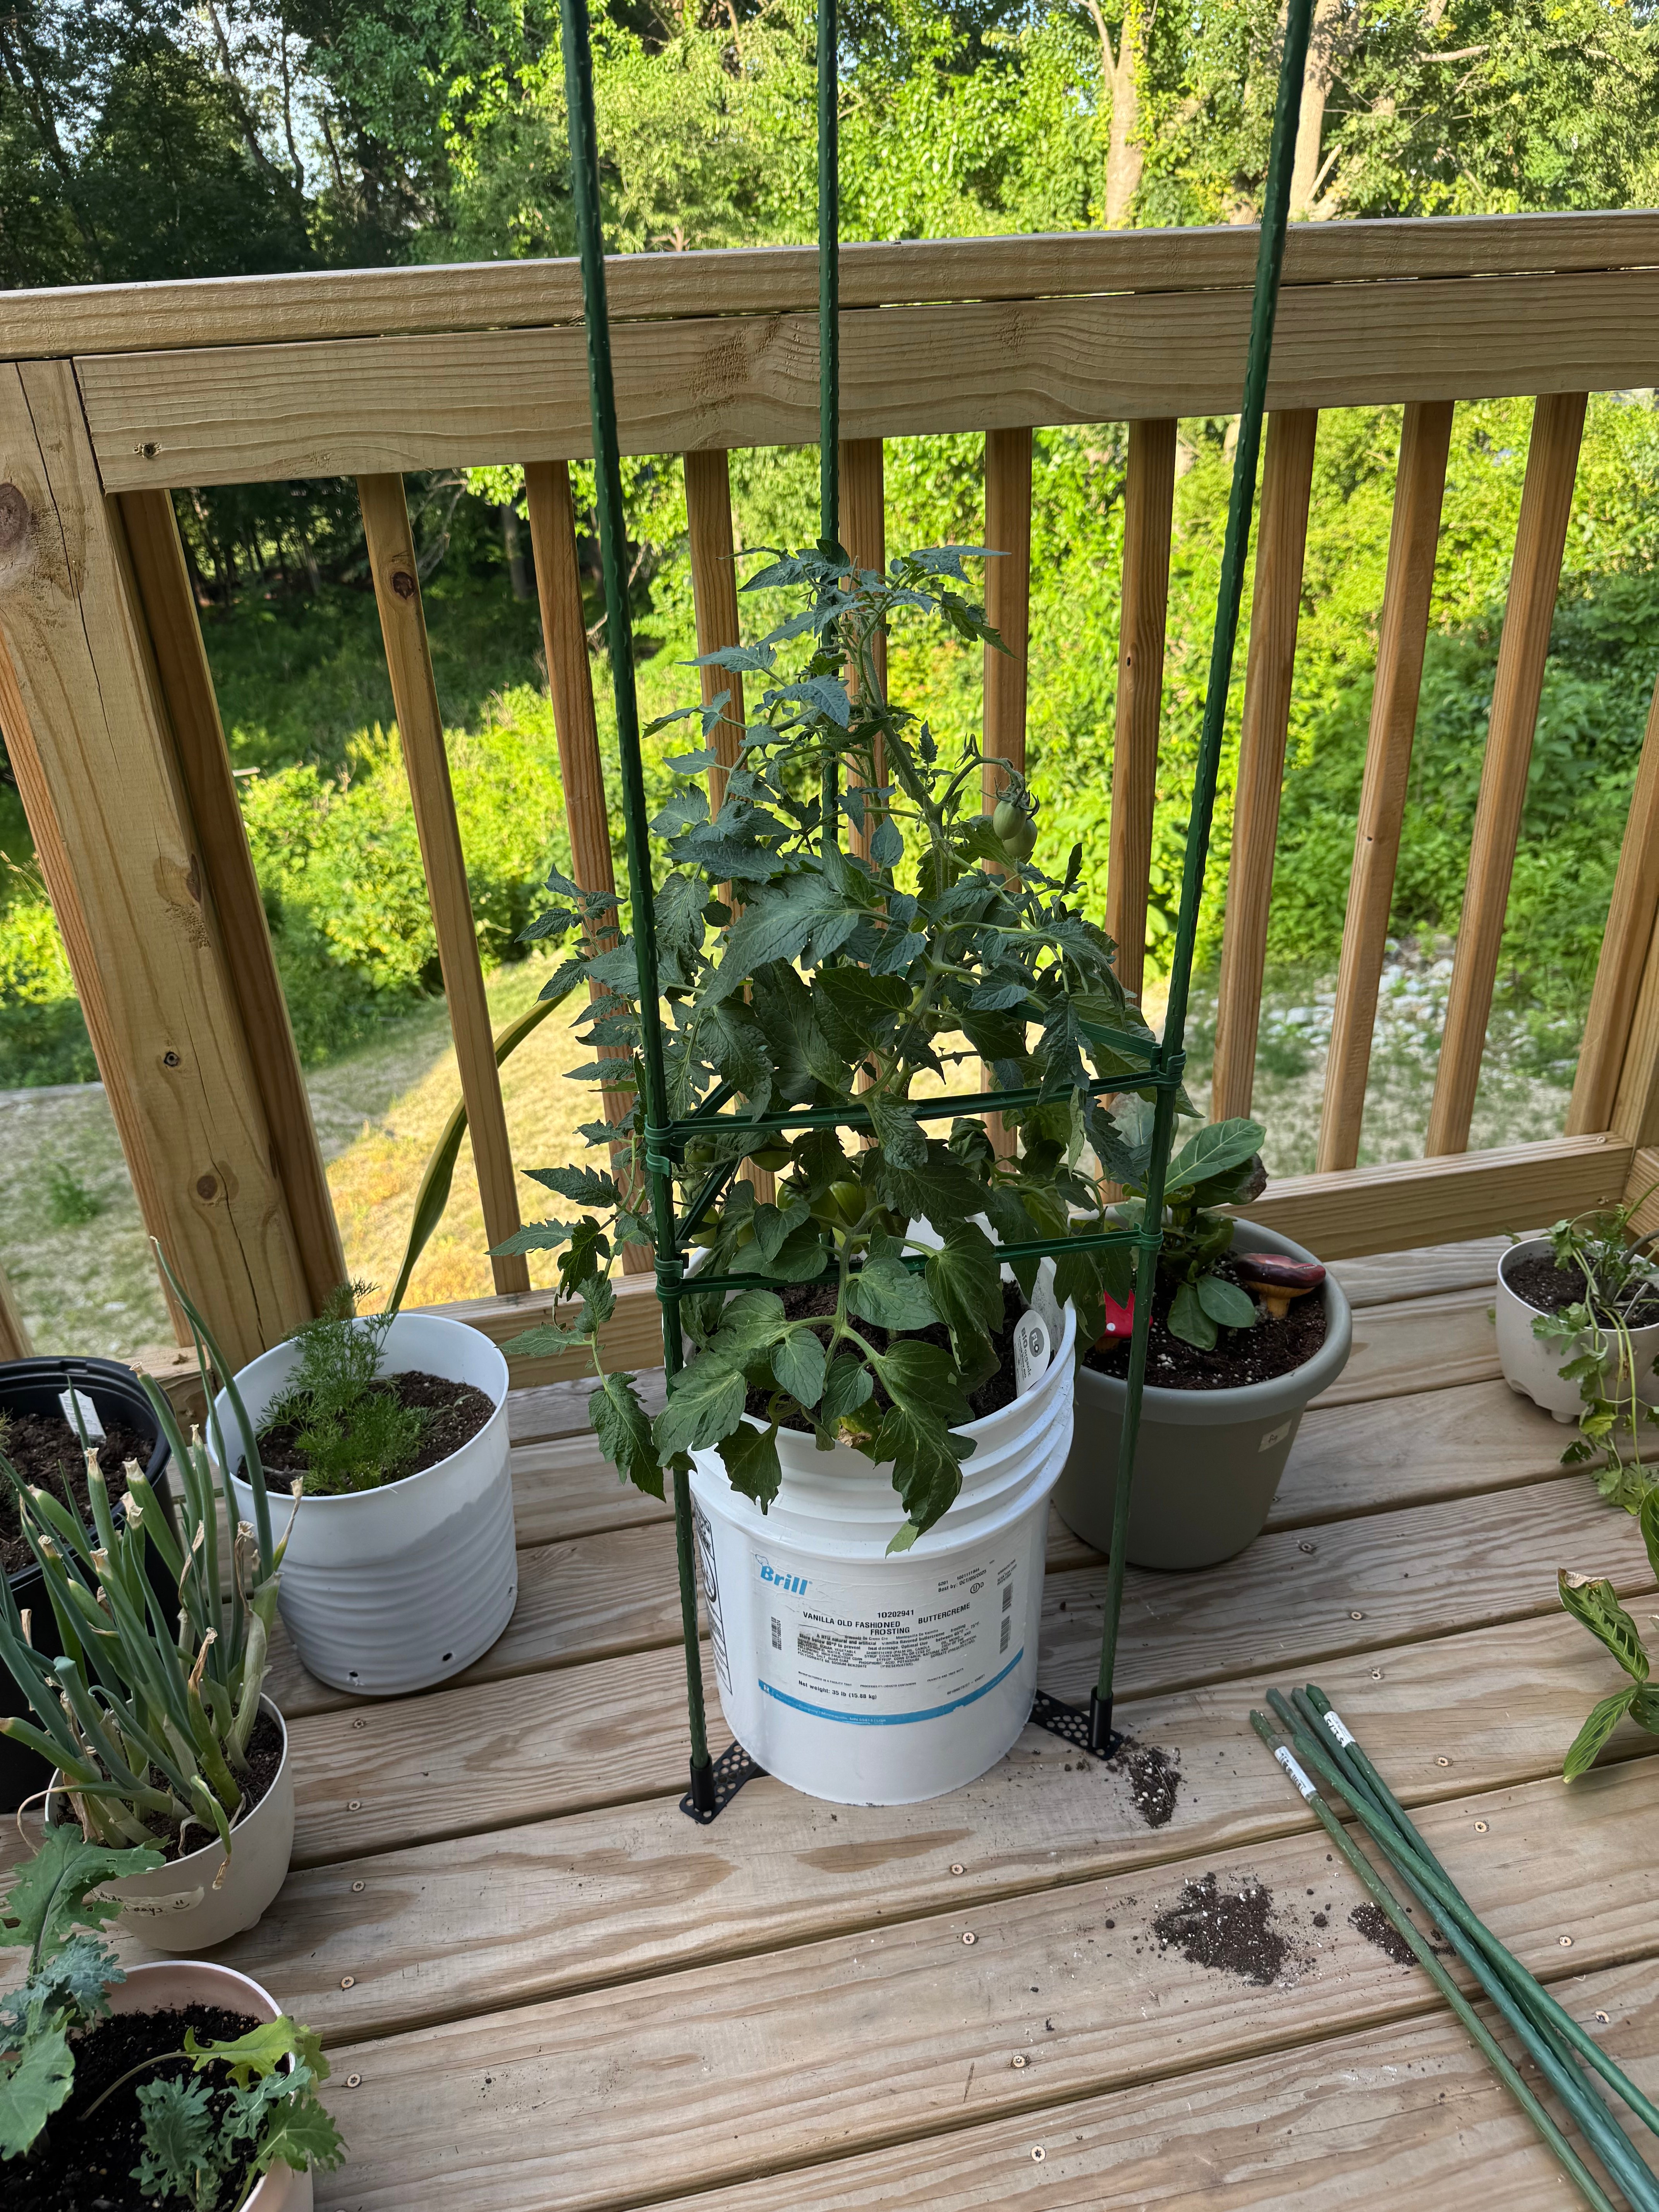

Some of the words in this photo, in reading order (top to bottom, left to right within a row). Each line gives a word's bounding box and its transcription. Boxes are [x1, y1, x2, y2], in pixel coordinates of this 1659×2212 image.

[1031, 1332, 1039, 1353] FLO
[761, 1566, 808, 1595] Brill
[803, 1611, 835, 1625] VANILLA
[918, 1602, 970, 1624] BUTTERCREME
[877, 1609, 914, 1618] 10202941
[871, 1627, 910, 1635] FROSTING
[936, 1634, 953, 1642] between
[810, 1685, 830, 1693] weight:
